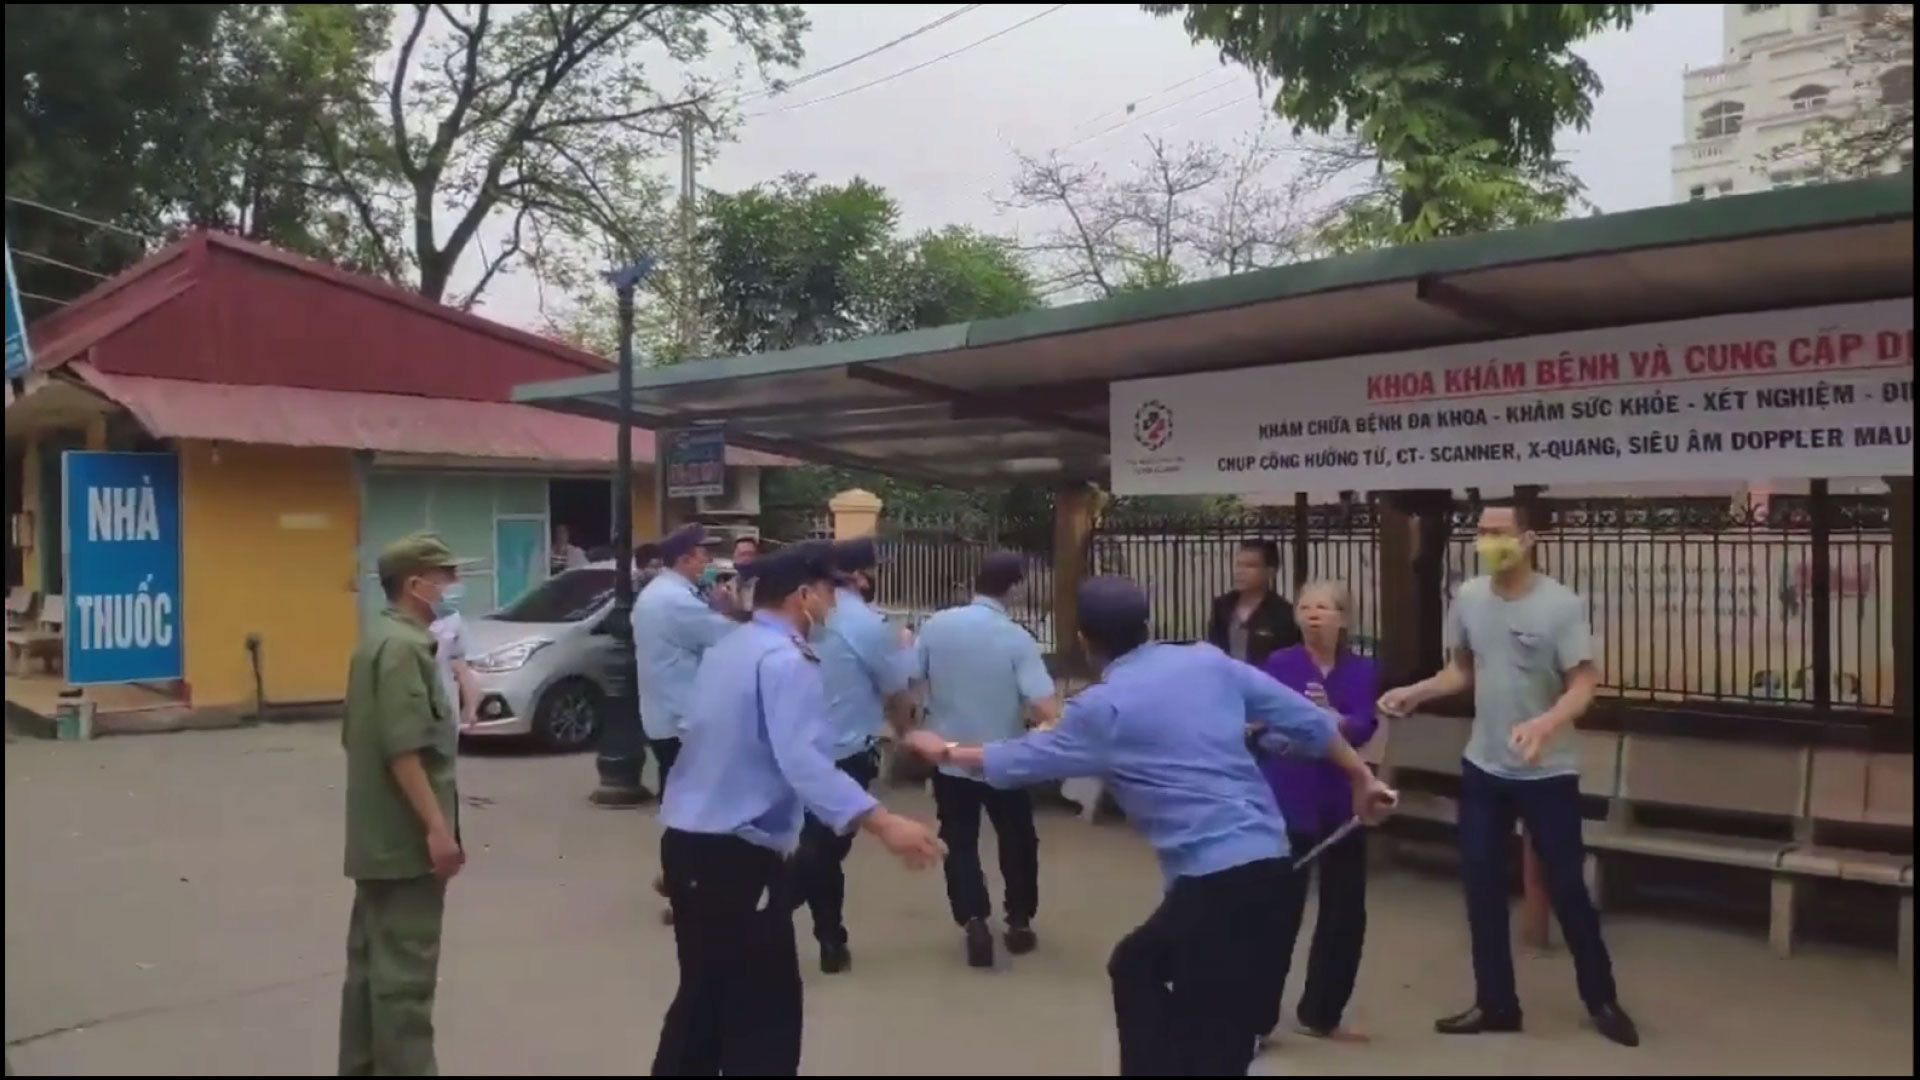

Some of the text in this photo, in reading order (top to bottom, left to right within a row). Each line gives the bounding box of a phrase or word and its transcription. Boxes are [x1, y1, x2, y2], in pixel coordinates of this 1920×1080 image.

[1367, 371, 1436, 400] KHOA
[1444, 358, 1527, 395] KHÁM
[1630, 342, 1673, 378] VÀ
[1684, 339, 1778, 374] CUNG
[1408, 411, 1433, 431] ĐA
[1436, 408, 1489, 430] KHOA
[1703, 386, 1749, 411] XÉT
[1756, 380, 1855, 411] NGHIỆM
[1527, 435, 1622, 460] X-QUANG,
[1628, 430, 1680, 454] SIÊU
[1686, 428, 1723, 452] ÂM
[1731, 427, 1845, 451] DOPPLER
[87, 474, 160, 542] NHÀ
[76, 573, 174, 651] THUỐC
